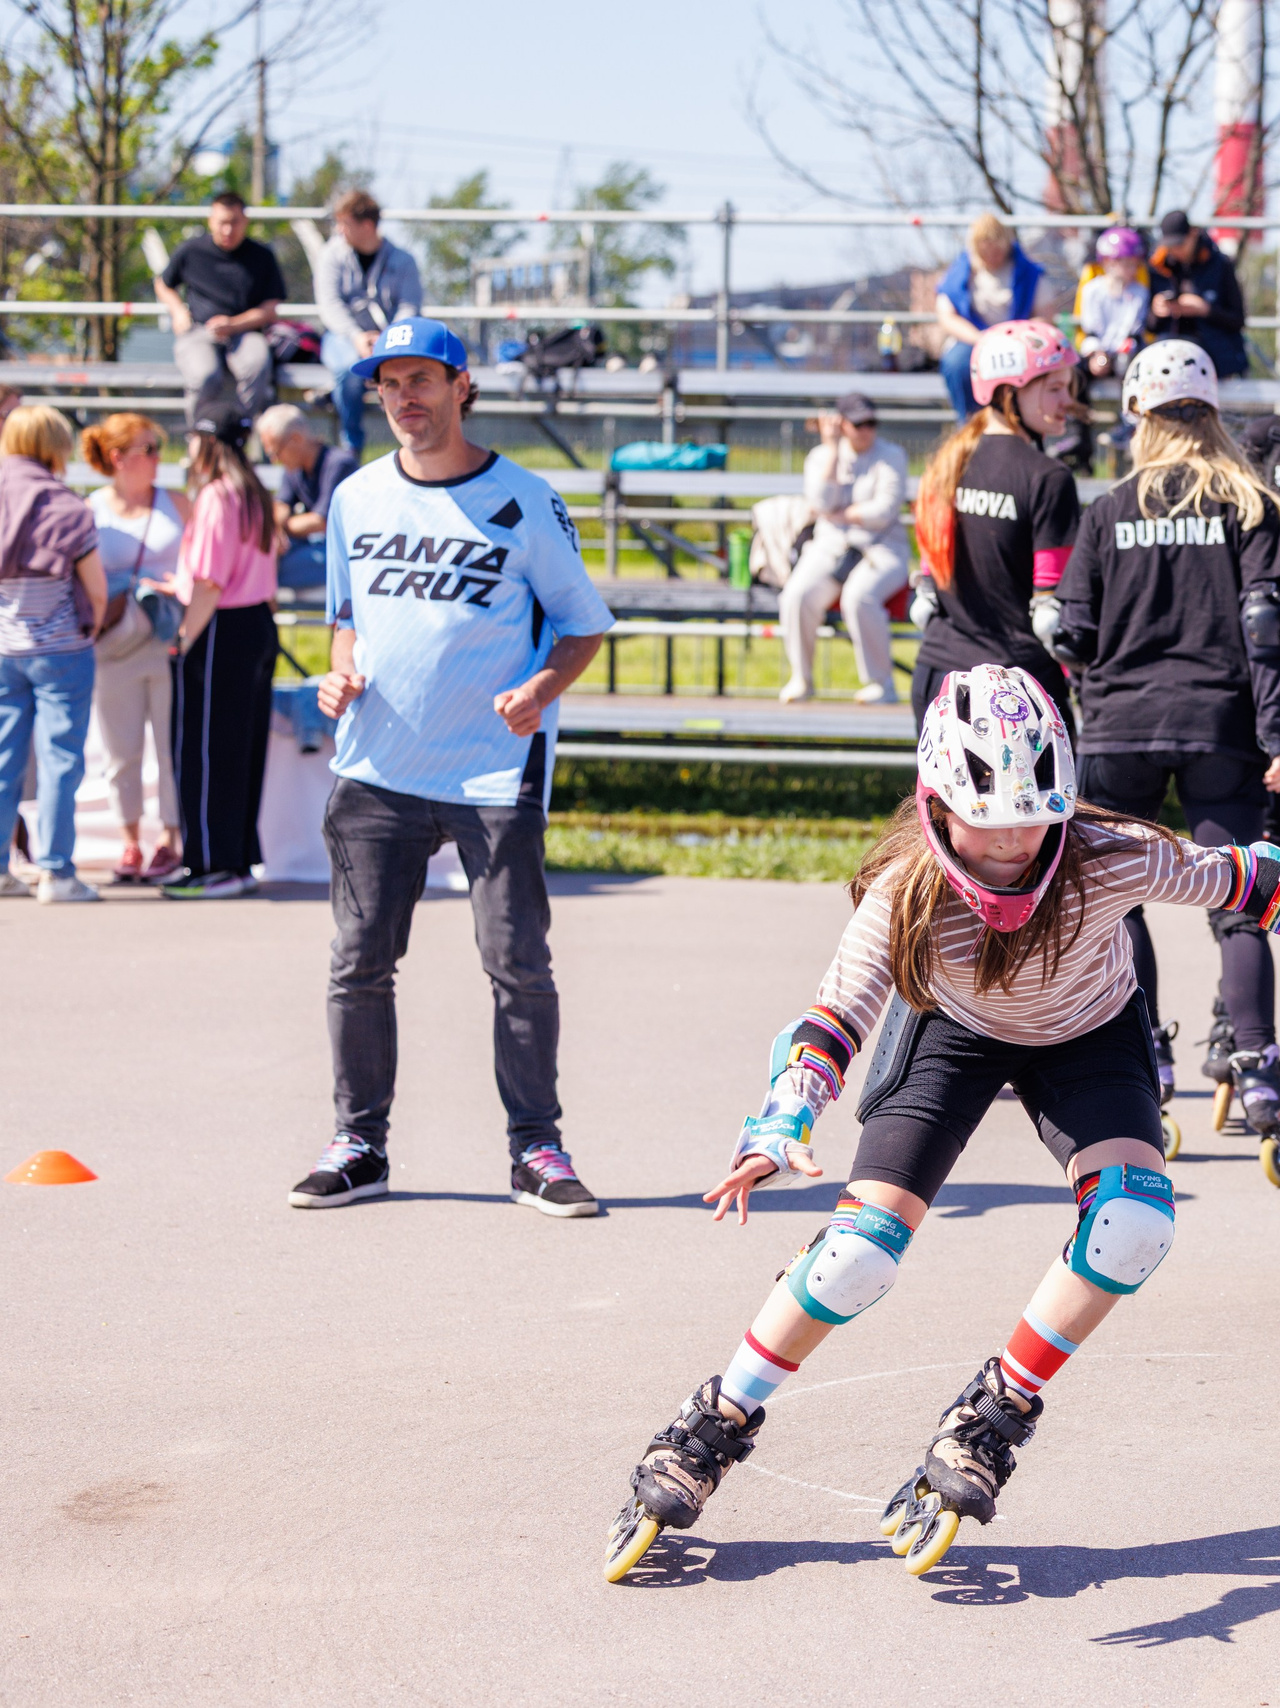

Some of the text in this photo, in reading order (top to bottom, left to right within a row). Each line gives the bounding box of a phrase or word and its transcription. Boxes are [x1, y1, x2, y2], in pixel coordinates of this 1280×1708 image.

[990, 353, 1017, 371] 113
[1115, 515, 1226, 550] DUDINA
[349, 533, 510, 574] SANTA
[368, 568, 502, 609] CRUZ
[1132, 1174, 1162, 1183] FLYING
[1143, 1181, 1169, 1190] EAGLE
[864, 1213, 898, 1230] FLYING
[873, 1223, 902, 1239] EAGLE
